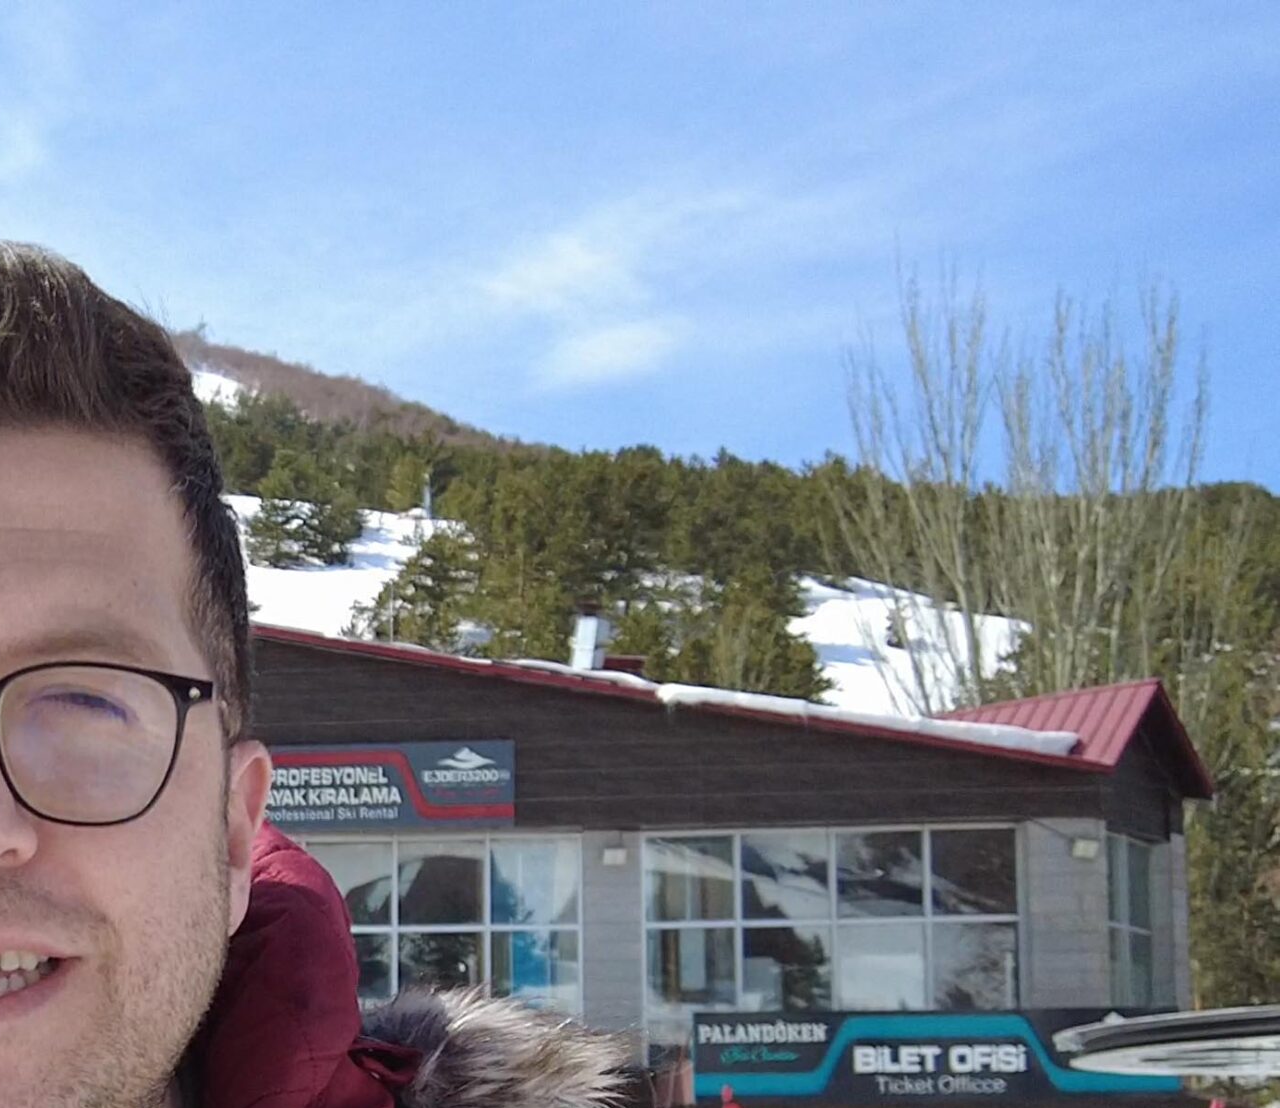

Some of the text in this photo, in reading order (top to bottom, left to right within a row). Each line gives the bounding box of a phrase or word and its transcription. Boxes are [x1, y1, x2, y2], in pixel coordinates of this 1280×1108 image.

[337, 806, 357, 821] Ski
[359, 806, 399, 820] Rental
[876, 1074, 935, 1094] Ticket
